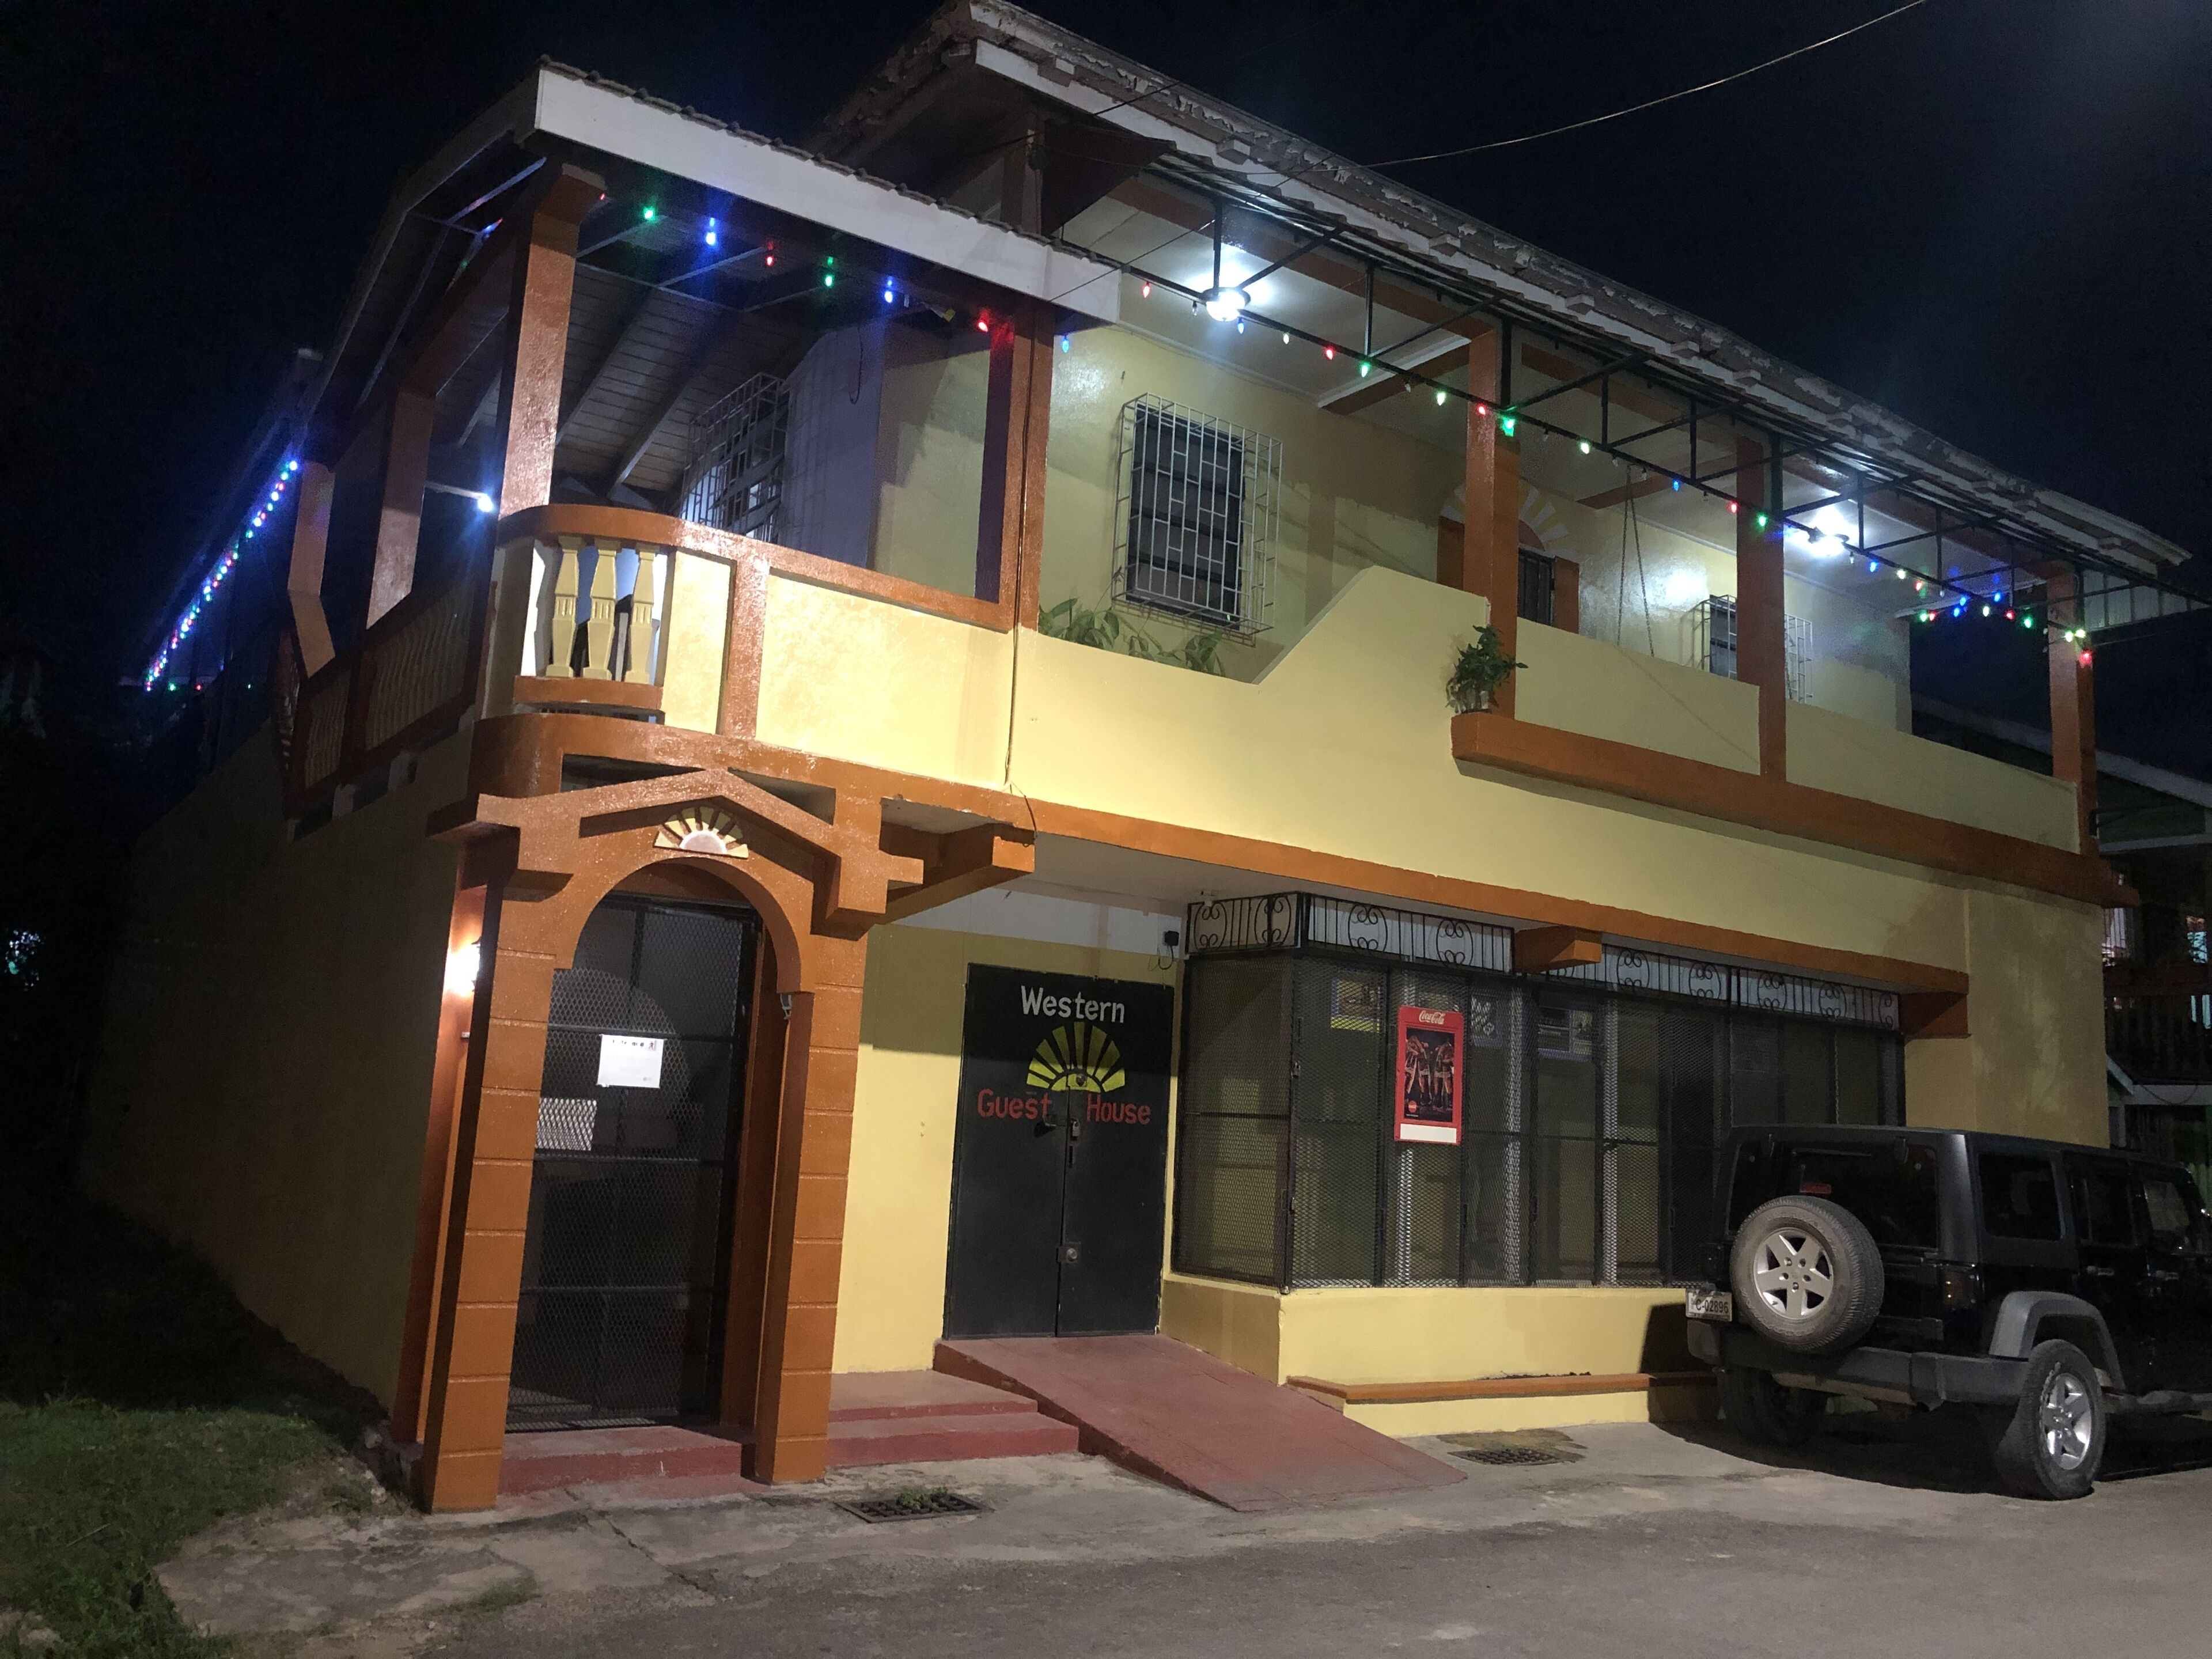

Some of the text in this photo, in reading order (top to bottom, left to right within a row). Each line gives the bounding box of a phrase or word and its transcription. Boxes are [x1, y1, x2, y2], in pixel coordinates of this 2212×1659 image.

[1021, 986, 1125, 1022] Western
[978, 1089, 1151, 1124] Guest House
[1696, 1298, 1729, 1313] C-02896
